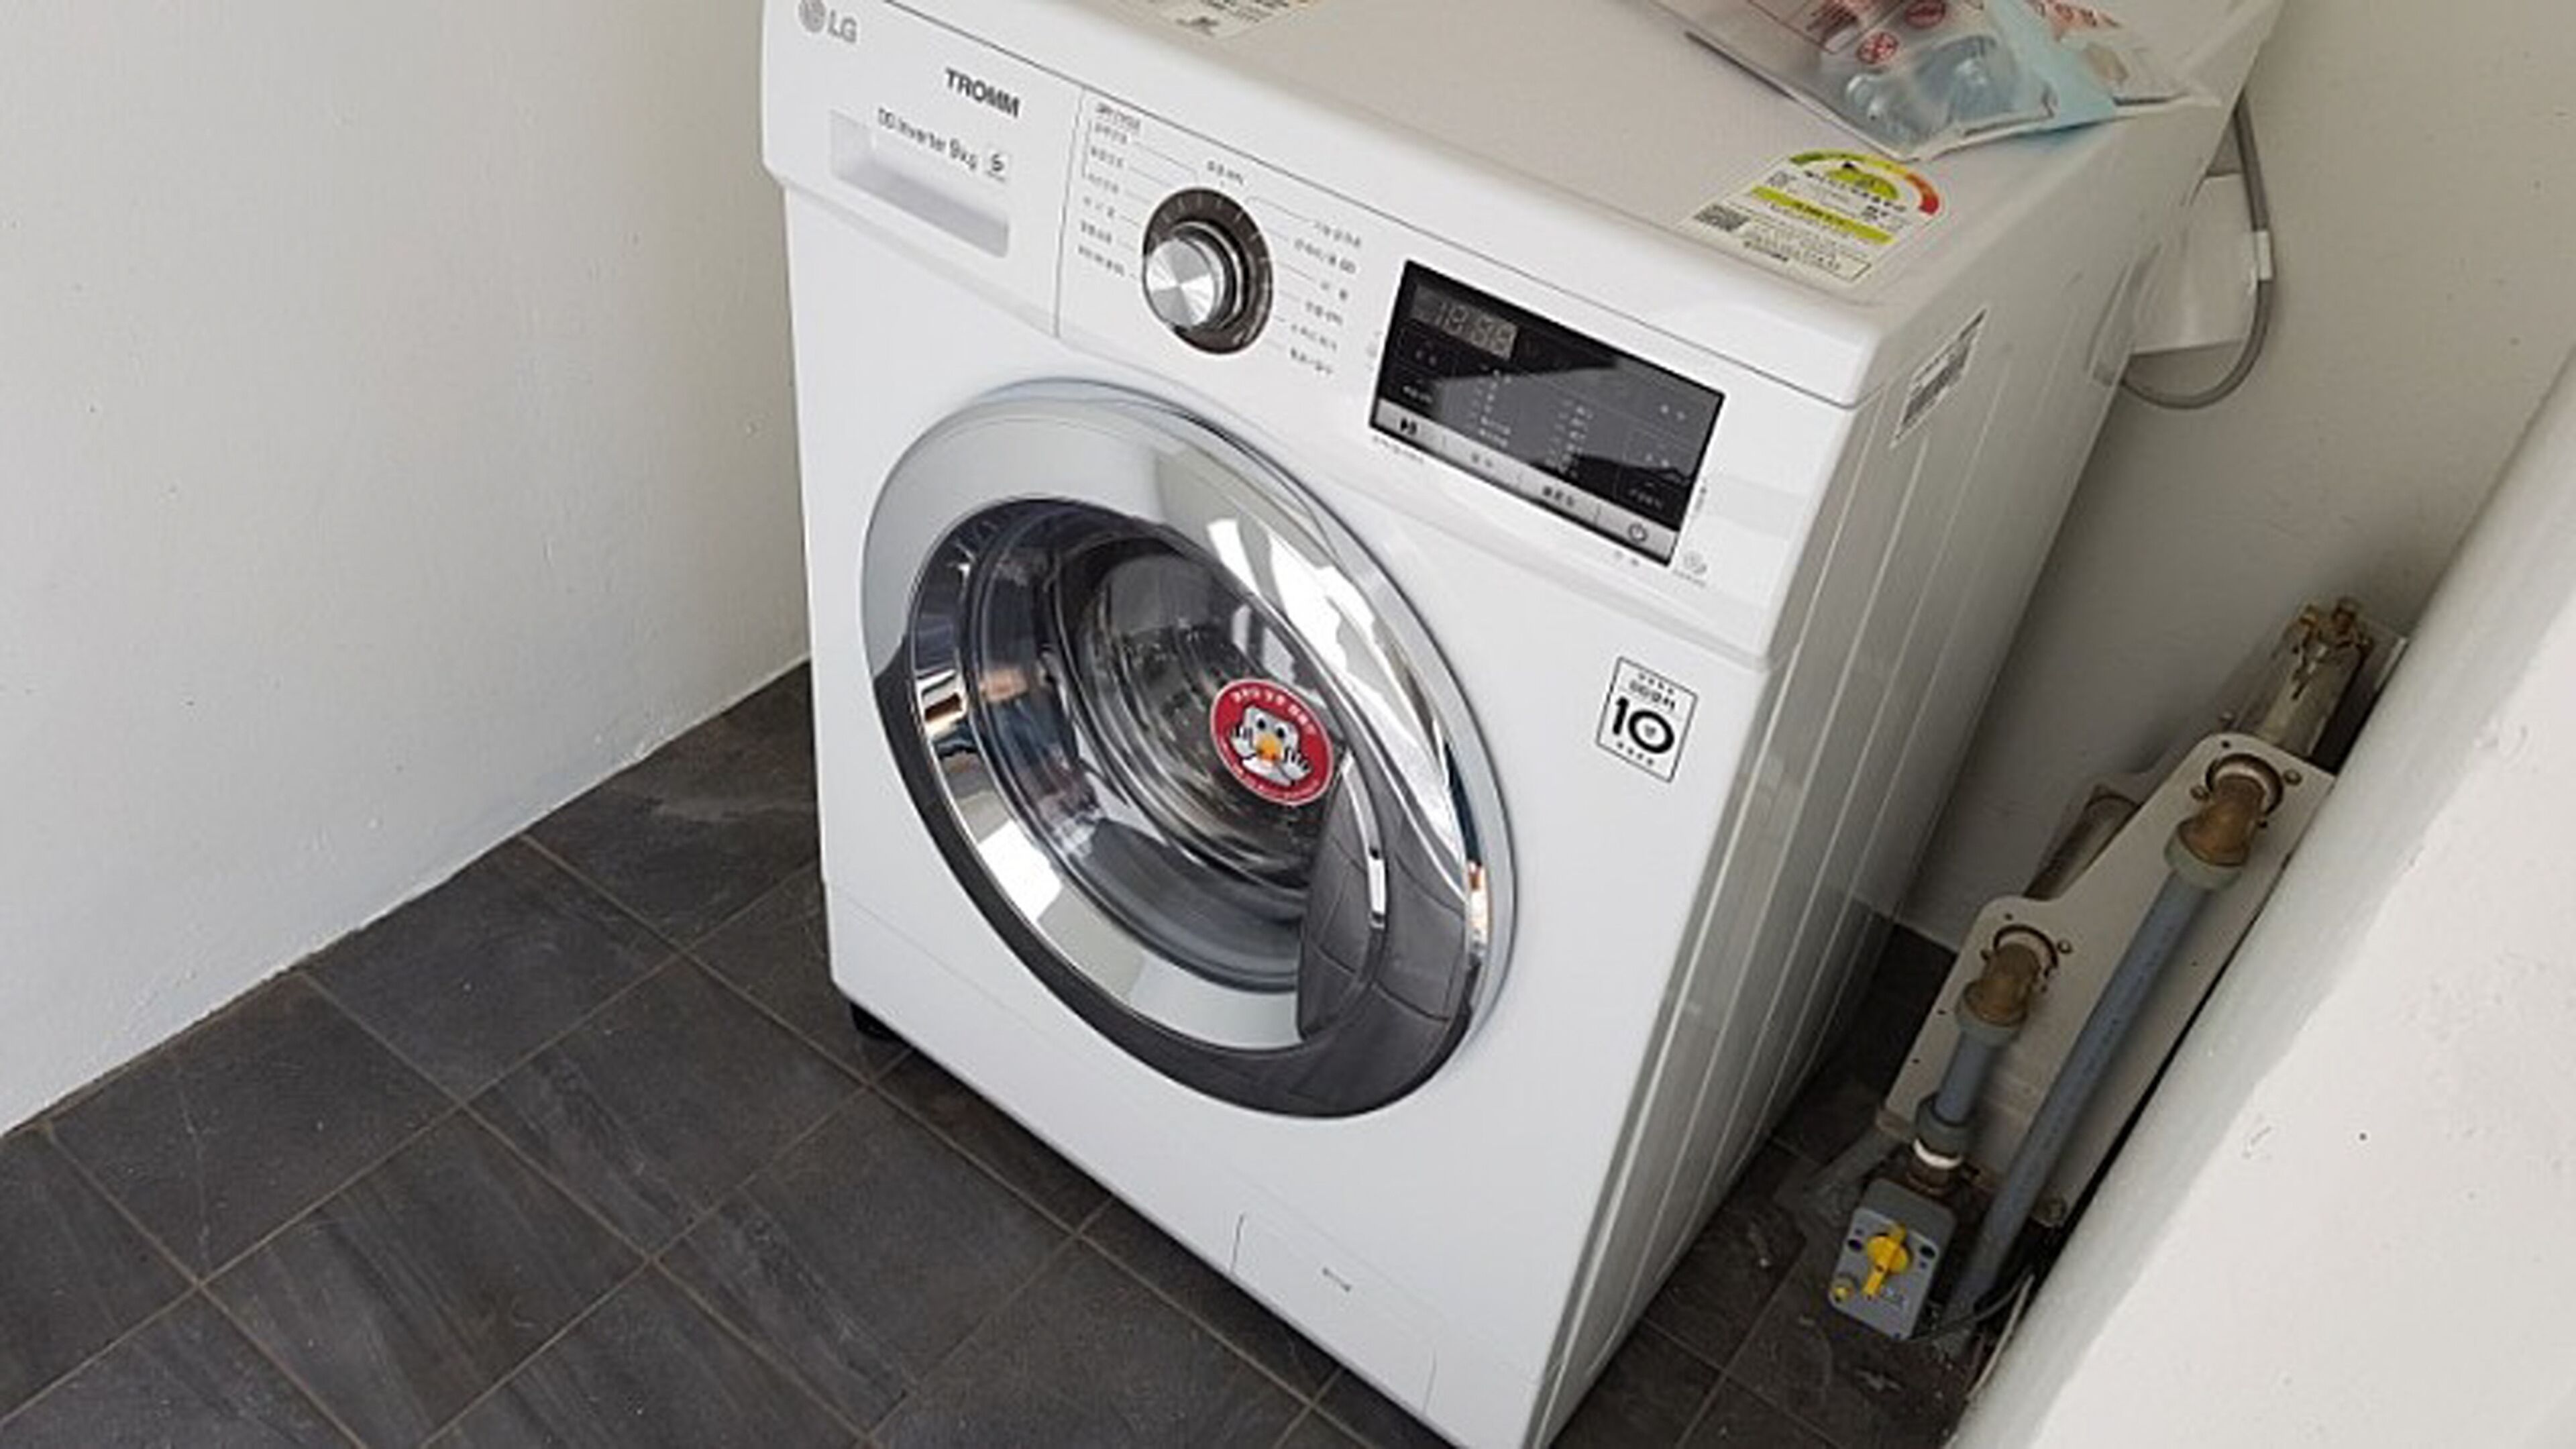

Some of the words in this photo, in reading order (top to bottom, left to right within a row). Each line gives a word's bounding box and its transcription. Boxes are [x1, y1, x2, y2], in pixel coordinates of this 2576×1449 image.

[827, 10, 857, 43] LG
[946, 67, 1020, 118] TROMM
[898, 117, 946, 152] Inverter
[1613, 696, 1675, 754] 10
